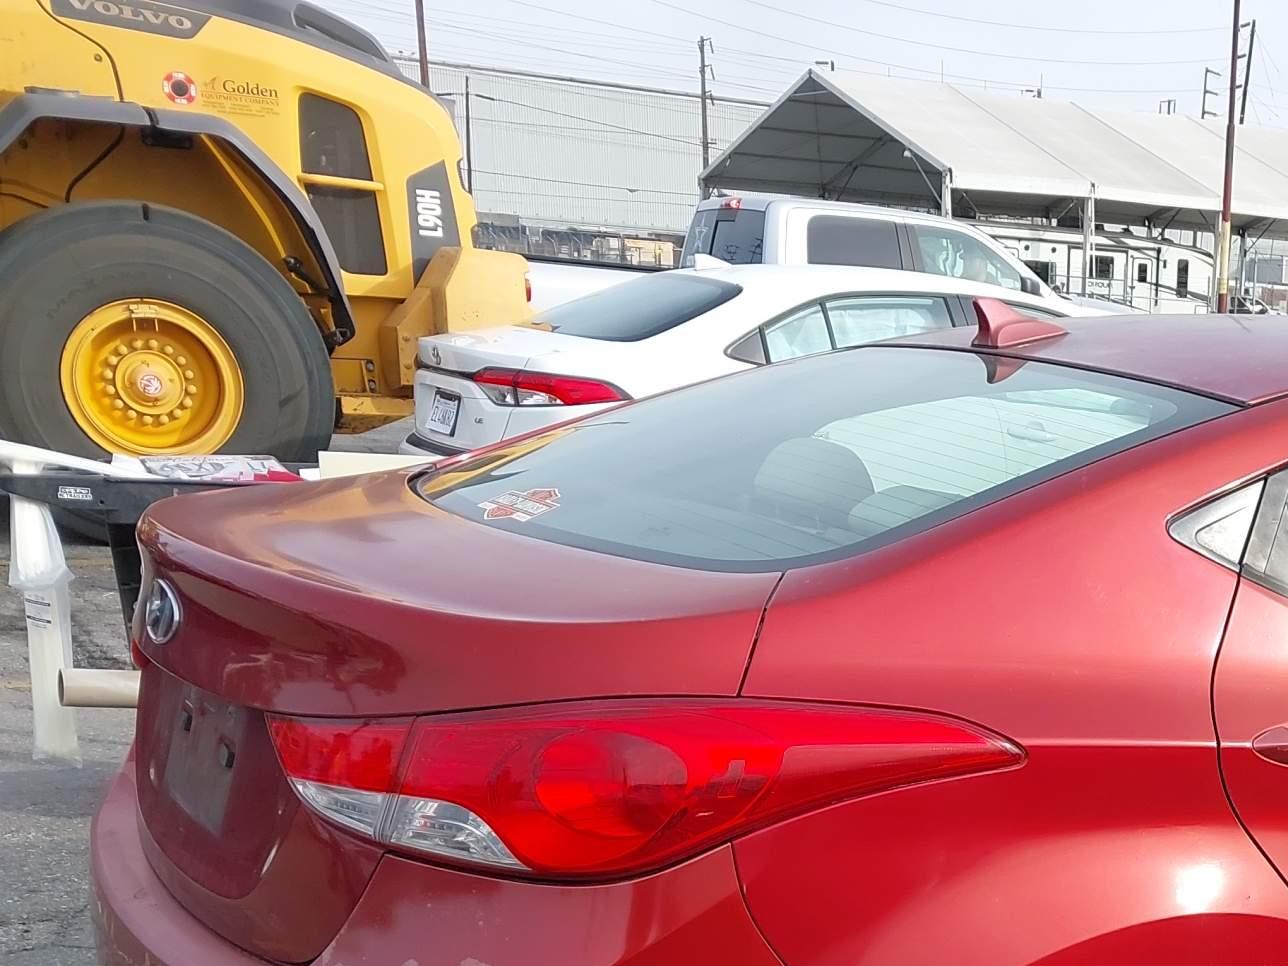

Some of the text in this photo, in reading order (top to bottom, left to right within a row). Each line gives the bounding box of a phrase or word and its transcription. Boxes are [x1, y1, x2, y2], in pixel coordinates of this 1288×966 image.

[69, 0, 193, 30] VOLVO
[222, 79, 279, 98] Golden
[415, 188, 443, 237] L90H
